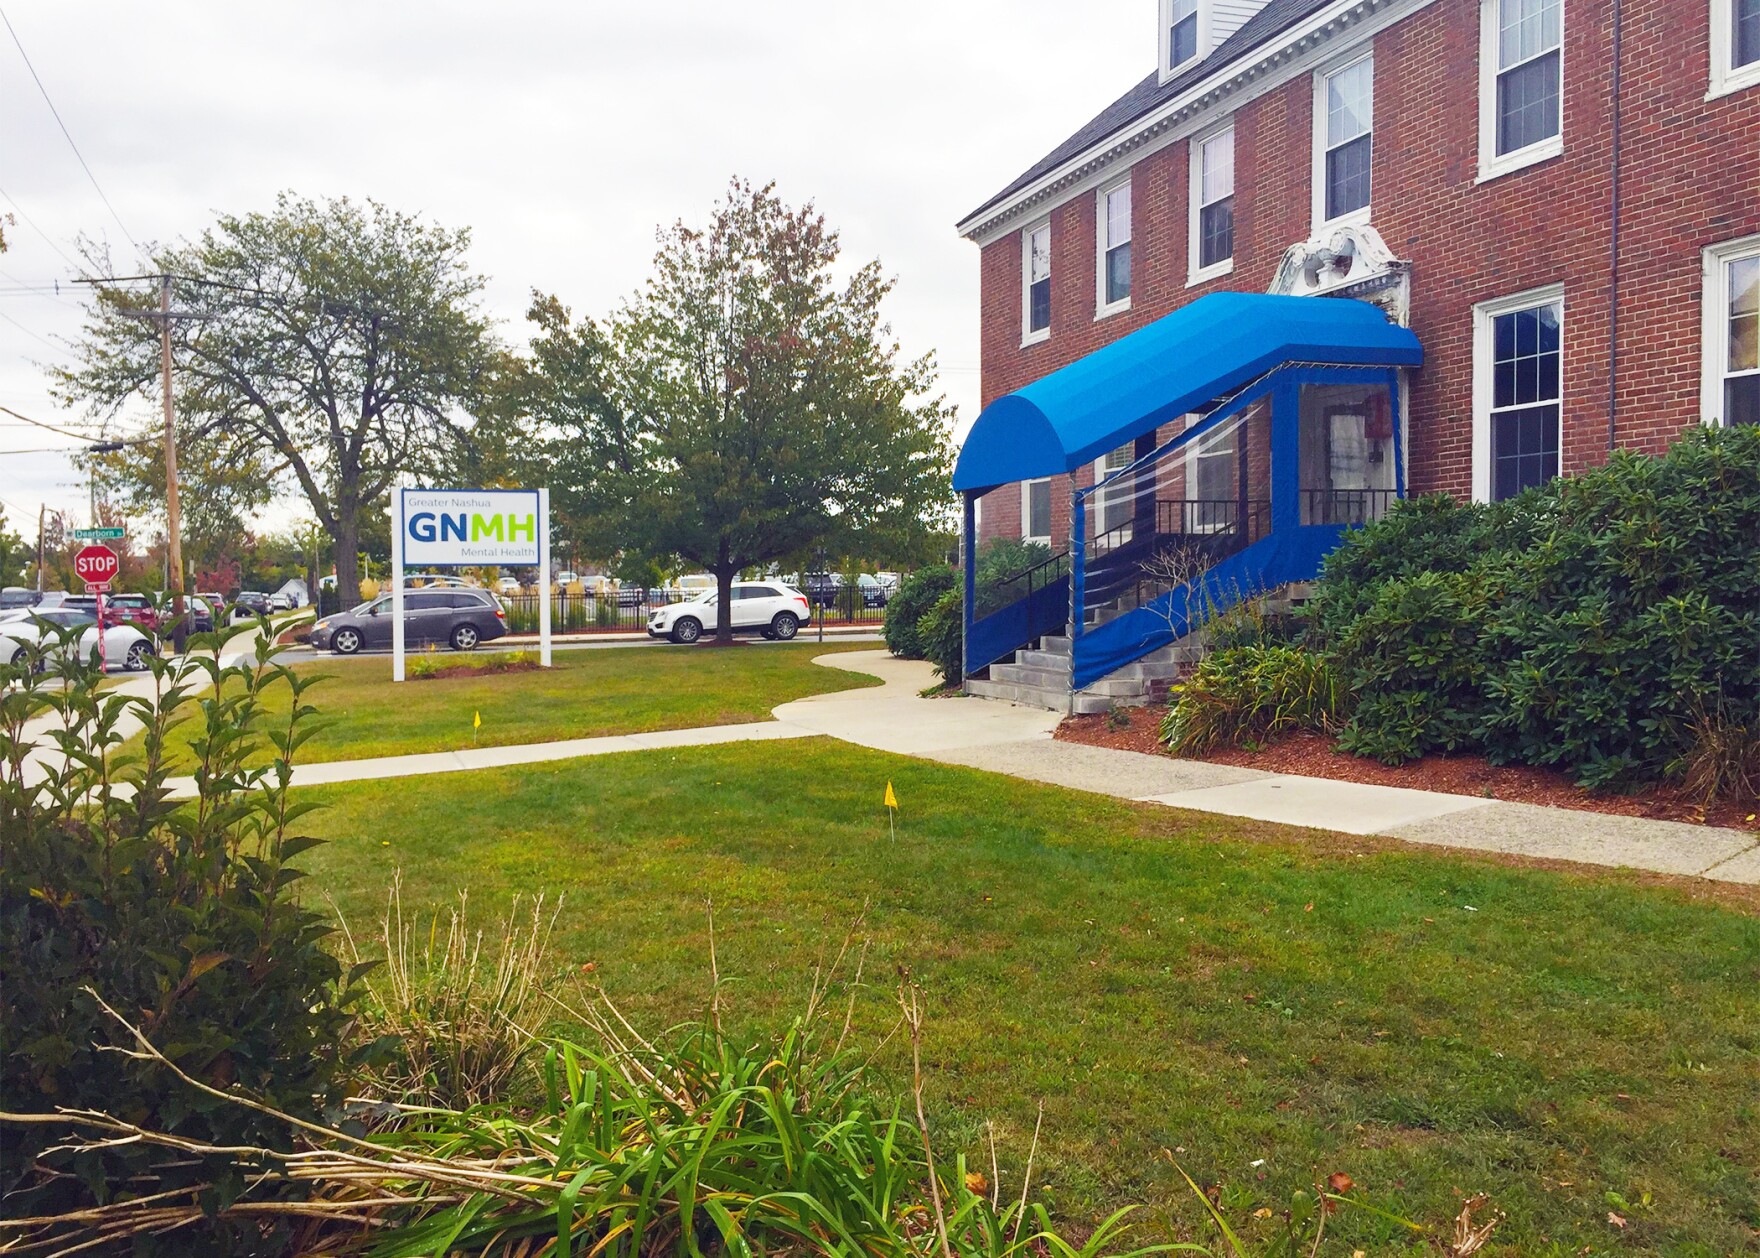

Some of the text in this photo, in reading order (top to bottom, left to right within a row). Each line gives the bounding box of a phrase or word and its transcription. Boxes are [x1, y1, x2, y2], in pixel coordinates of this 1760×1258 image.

[408, 497, 491, 508] Greater Nashua
[408, 512, 534, 543] GNMH
[77, 530, 114, 538] Dearborn
[461, 548, 535, 557] Mental Health
[78, 556, 115, 573] STOP
